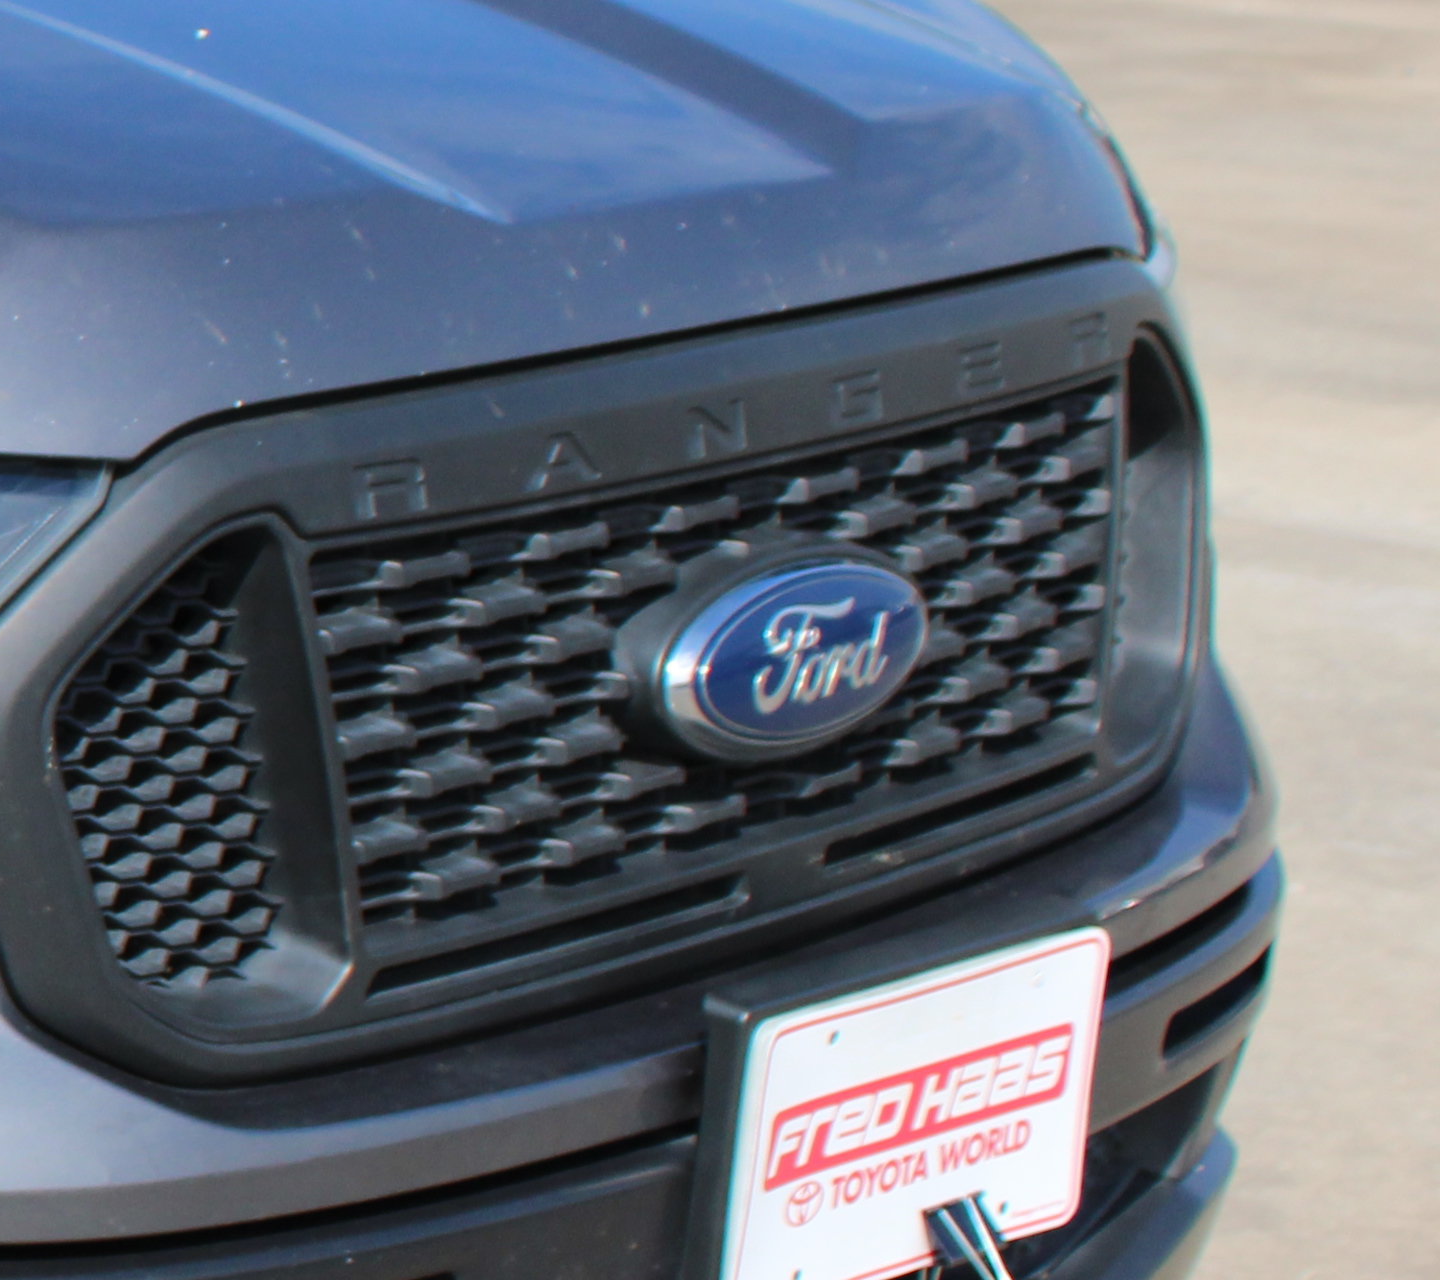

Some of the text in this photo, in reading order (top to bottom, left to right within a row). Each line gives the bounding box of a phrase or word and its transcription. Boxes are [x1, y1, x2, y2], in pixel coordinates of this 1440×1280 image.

[352, 310, 1112, 519] RANGER
[753, 596, 890, 715] Ford
[831, 1118, 1032, 1208] TOYOTA WORLD
